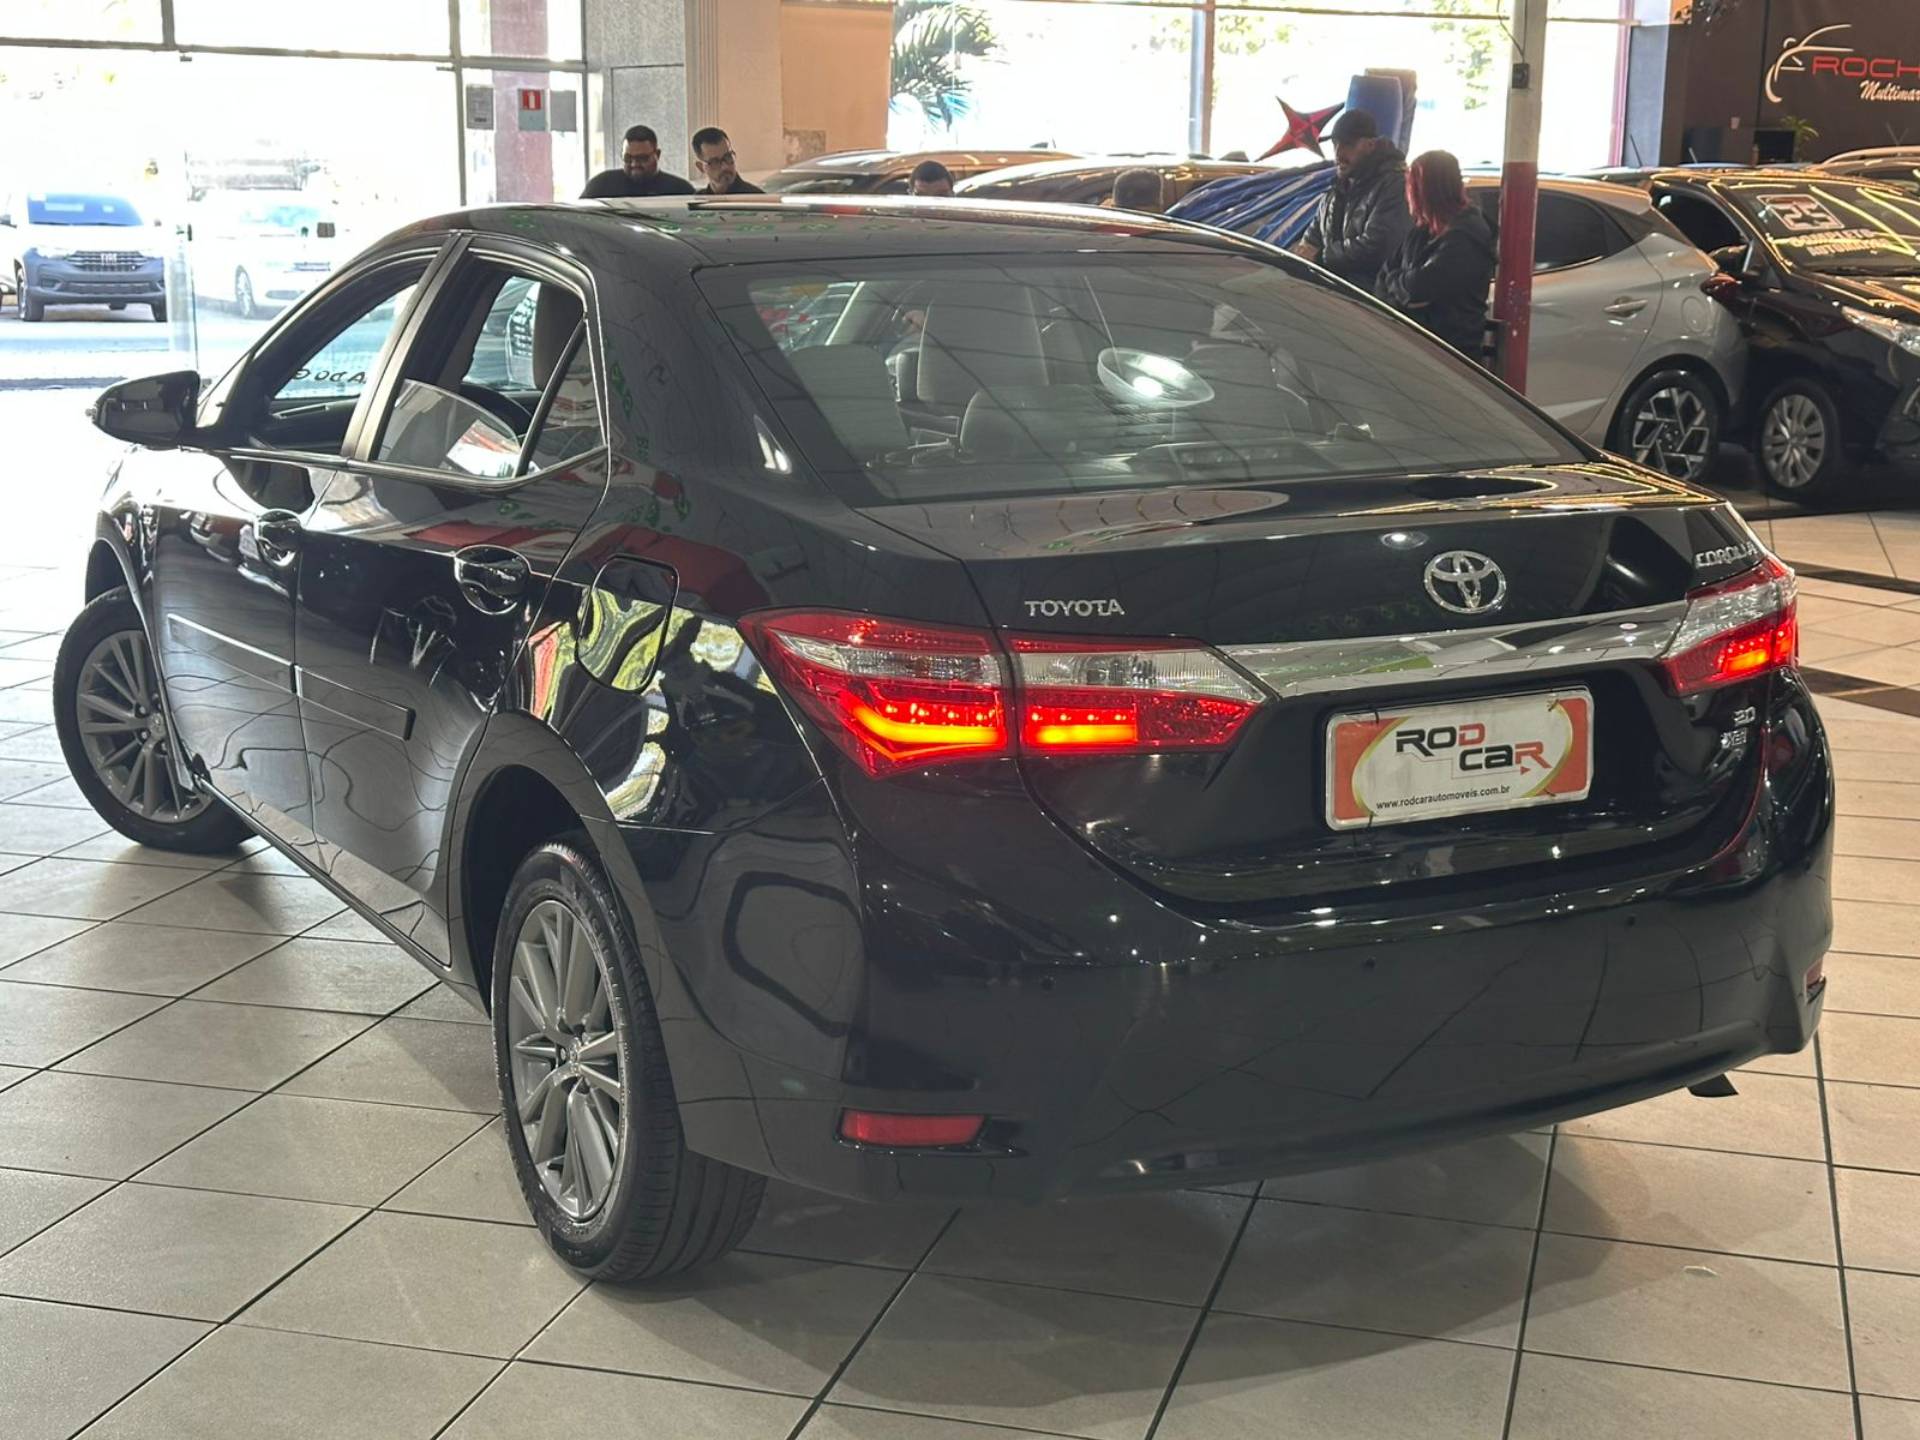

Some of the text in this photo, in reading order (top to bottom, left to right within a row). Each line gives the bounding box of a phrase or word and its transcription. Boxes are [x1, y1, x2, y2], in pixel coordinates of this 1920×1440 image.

[1812, 55, 1920, 78] ROCH
[1024, 599, 1125, 616] TOYOTA
[1396, 723, 1486, 757] ROD
[1376, 784, 1511, 810] www.rodcarautomoveis.com.br
